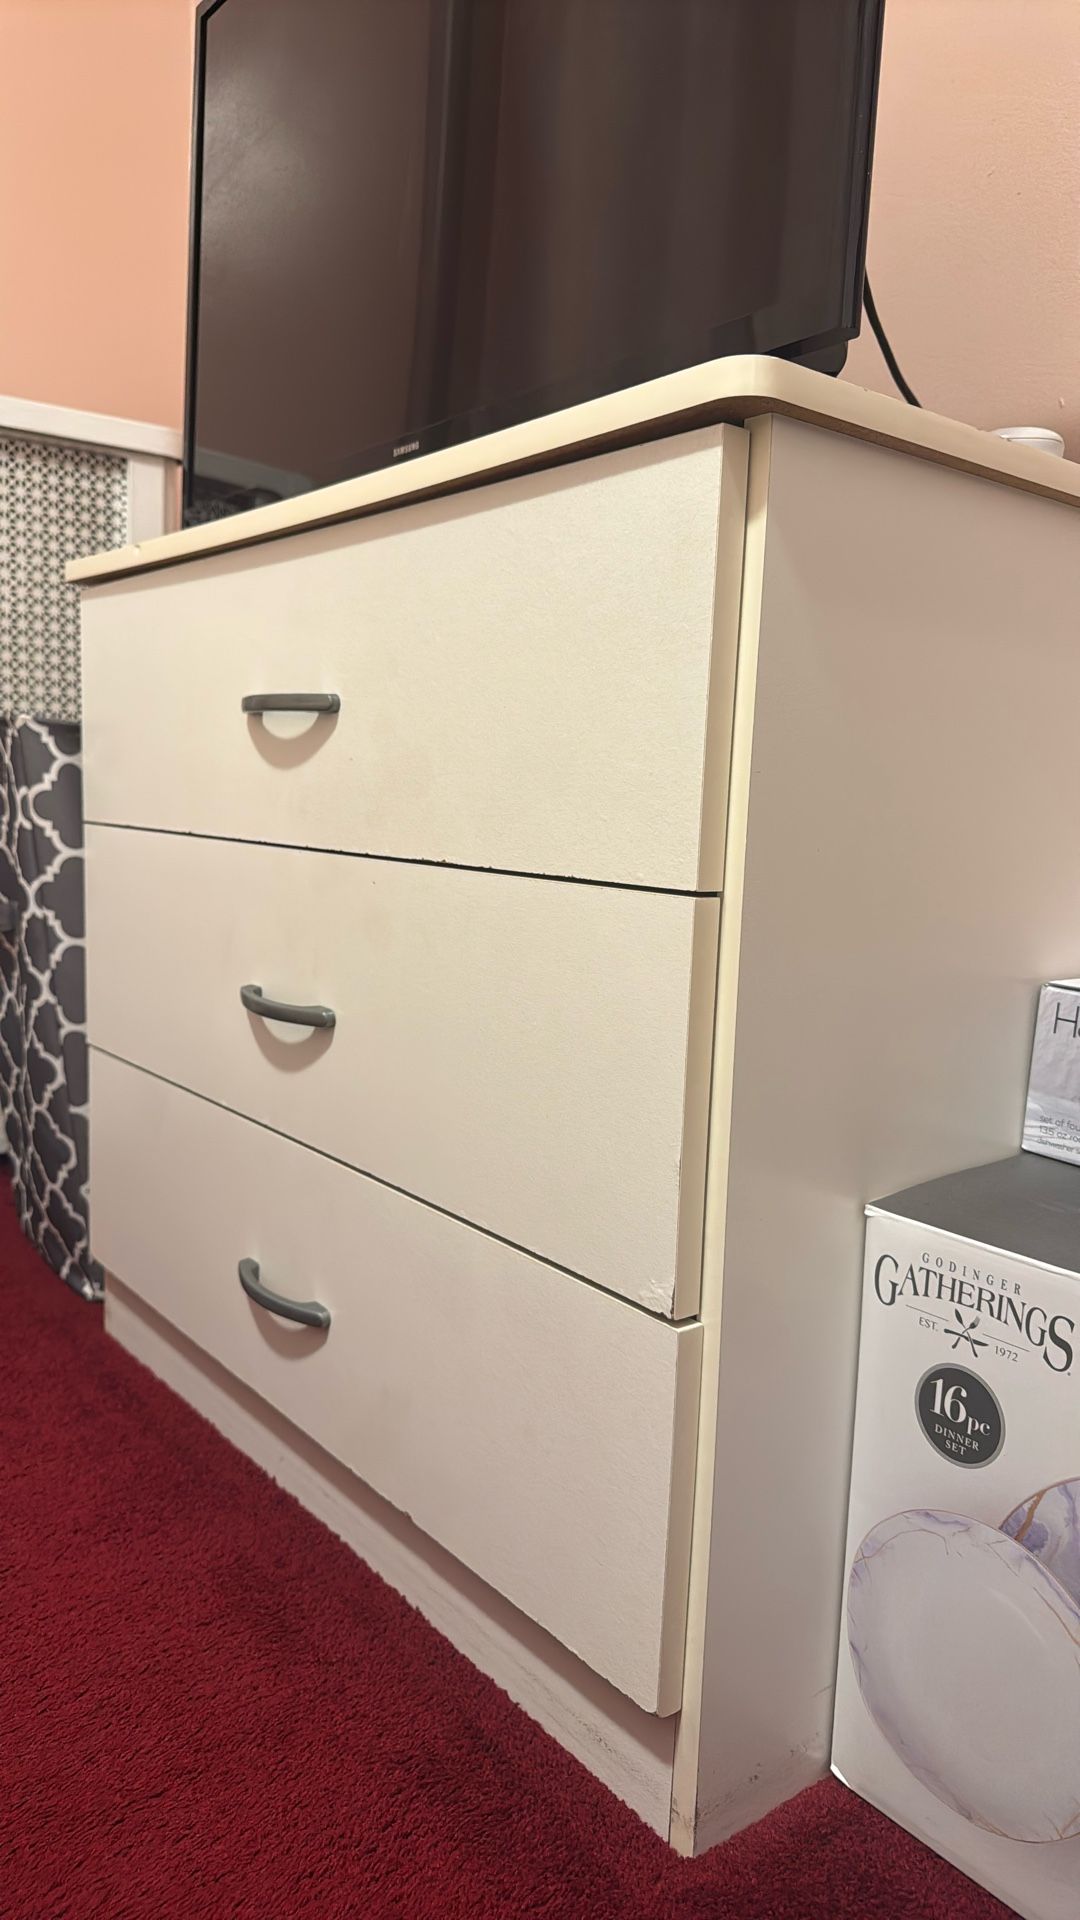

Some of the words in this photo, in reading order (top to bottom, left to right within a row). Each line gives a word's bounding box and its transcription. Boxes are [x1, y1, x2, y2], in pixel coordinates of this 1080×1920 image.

[1053, 1002, 1080, 1039] H
[1055, 1118, 1065, 1128] of
[1057, 1131, 1068, 1140] oz
[921, 1252, 1023, 1296] GODINGER
[874, 1254, 1075, 1373] GATHERINGS
[918, 1316, 939, 1332] EST.
[994, 1345, 1019, 1363] 1972
[934, 1422, 980, 1452] DINNER
[944, 1438, 968, 1456] SET
